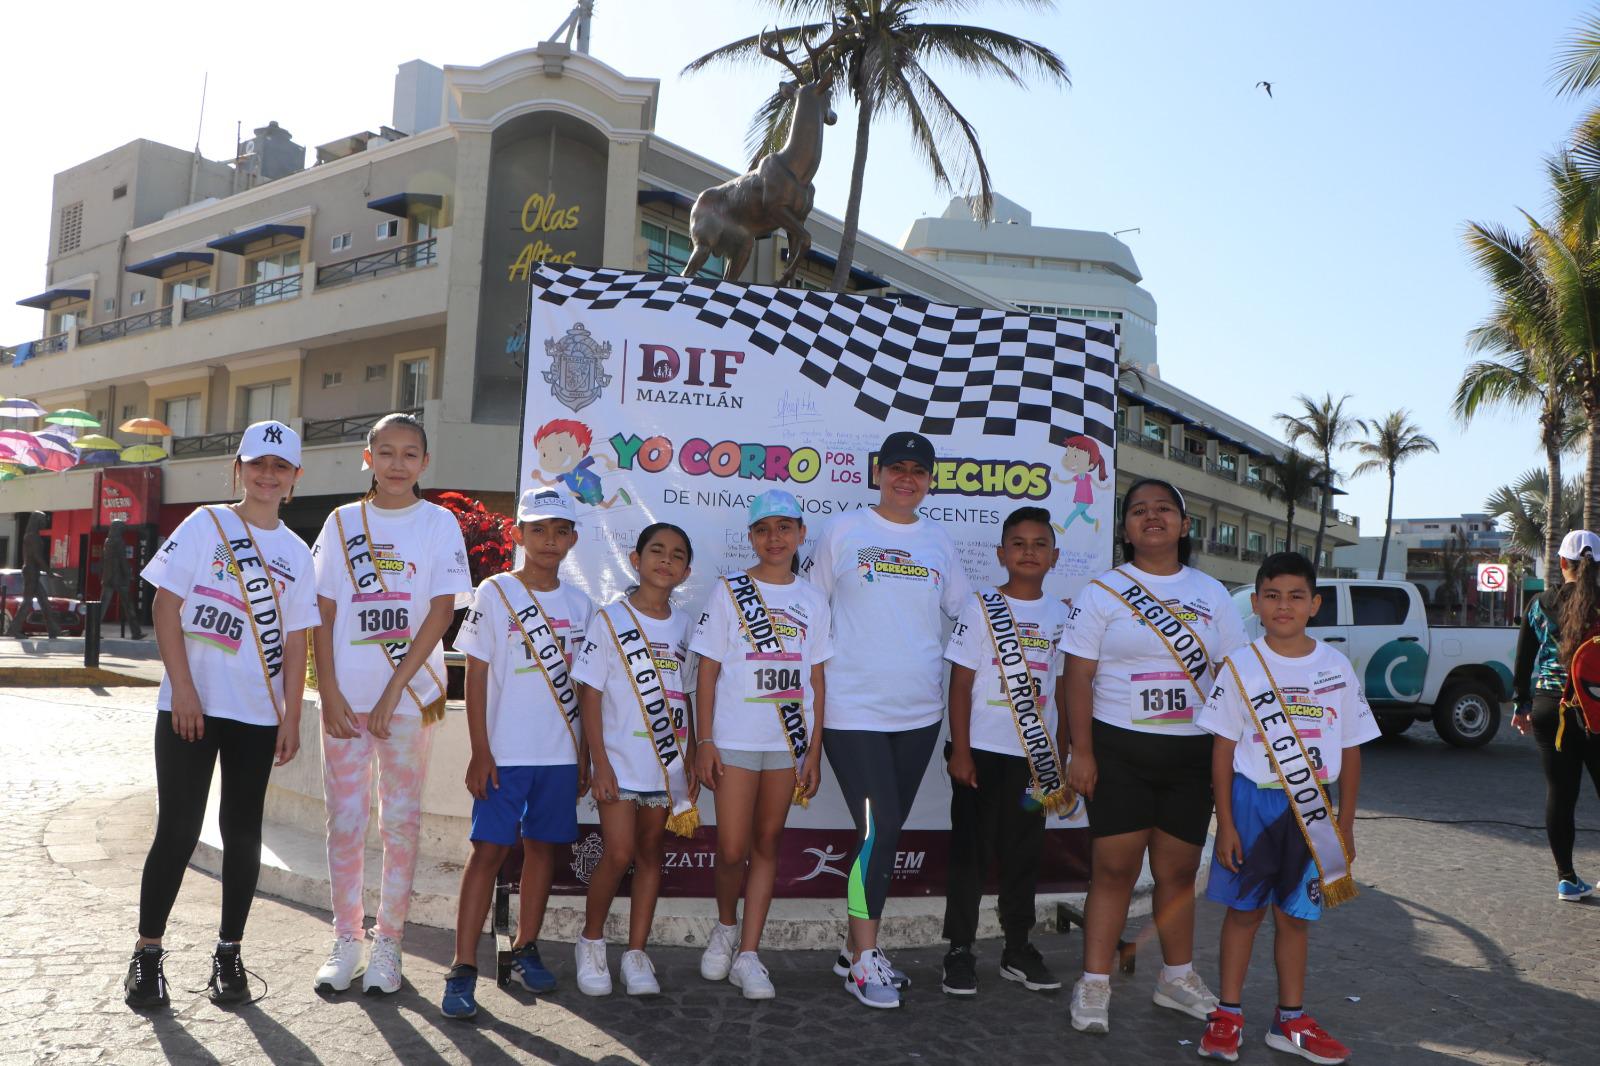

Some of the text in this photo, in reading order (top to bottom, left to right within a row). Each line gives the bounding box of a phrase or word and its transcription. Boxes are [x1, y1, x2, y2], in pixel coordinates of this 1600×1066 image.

[520, 193, 580, 233] Olas
[636, 343, 746, 389] DIF
[636, 388, 744, 409] MAZATLÁN
[609, 432, 674, 473] YO
[679, 437, 822, 483] CORRO
[825, 451, 855, 466] POR
[832, 470, 861, 484] LOS
[664, 489, 691, 505] DE
[697, 489, 757, 508] NIÑAS
[795, 495, 832, 514] ÑOS
[875, 561, 929, 577] DERECHOS
[192, 604, 245, 641] 1305
[230, 538, 284, 679] REGIDORA
[358, 608, 409, 633] 1306
[1121, 584, 1208, 681] REGIDORA
[516, 605, 580, 724] REGIDOR
[753, 668, 802, 691] 1304
[617, 628, 679, 768] REGIDORA
[1139, 688, 1187, 711] 1315
[1006, 672, 1061, 796] PROCURADOR
[1250, 690, 1328, 826] REGIDOR
